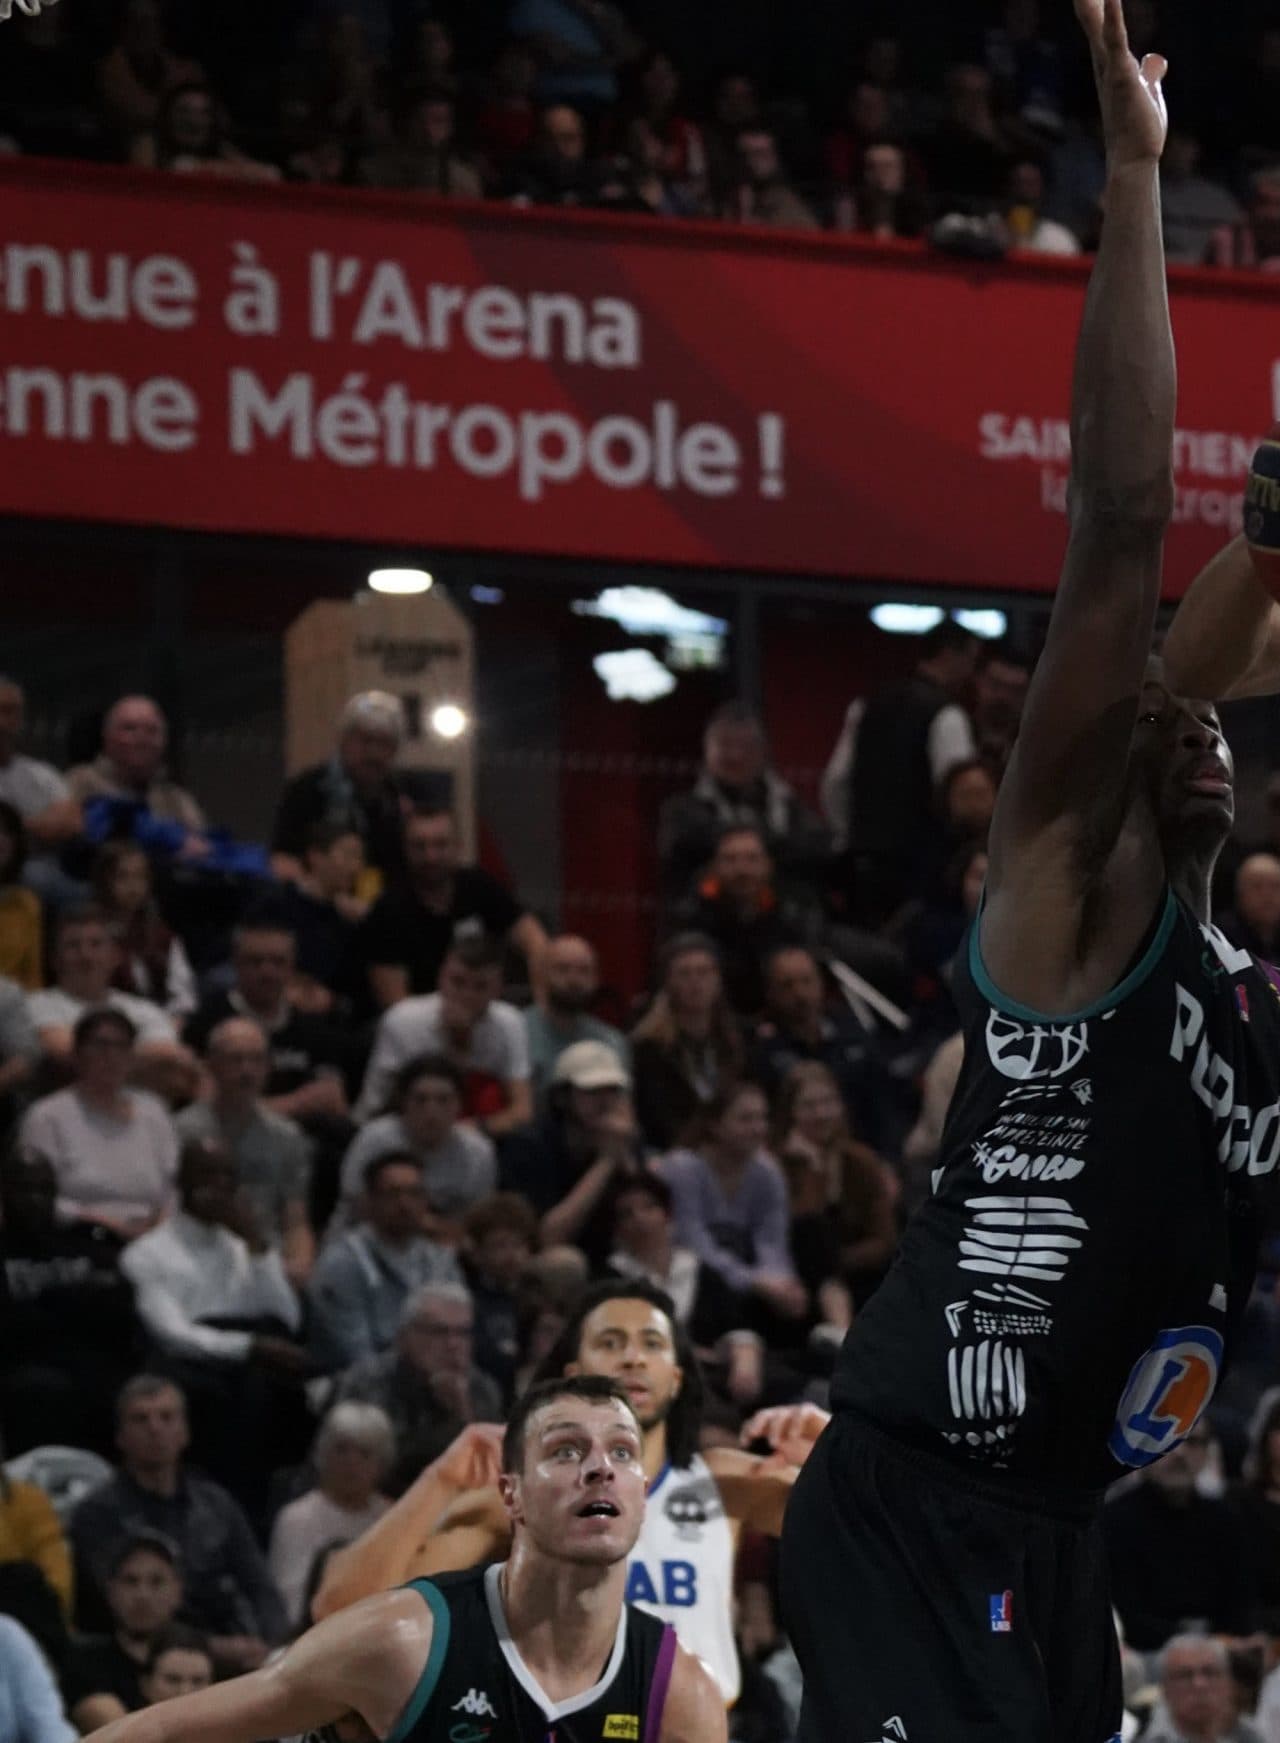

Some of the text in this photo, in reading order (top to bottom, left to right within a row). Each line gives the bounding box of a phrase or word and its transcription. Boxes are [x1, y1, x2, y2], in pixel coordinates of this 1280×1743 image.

[0, 238, 642, 370] nue à l'Arena
[0, 364, 787, 502] nne Métropole !
